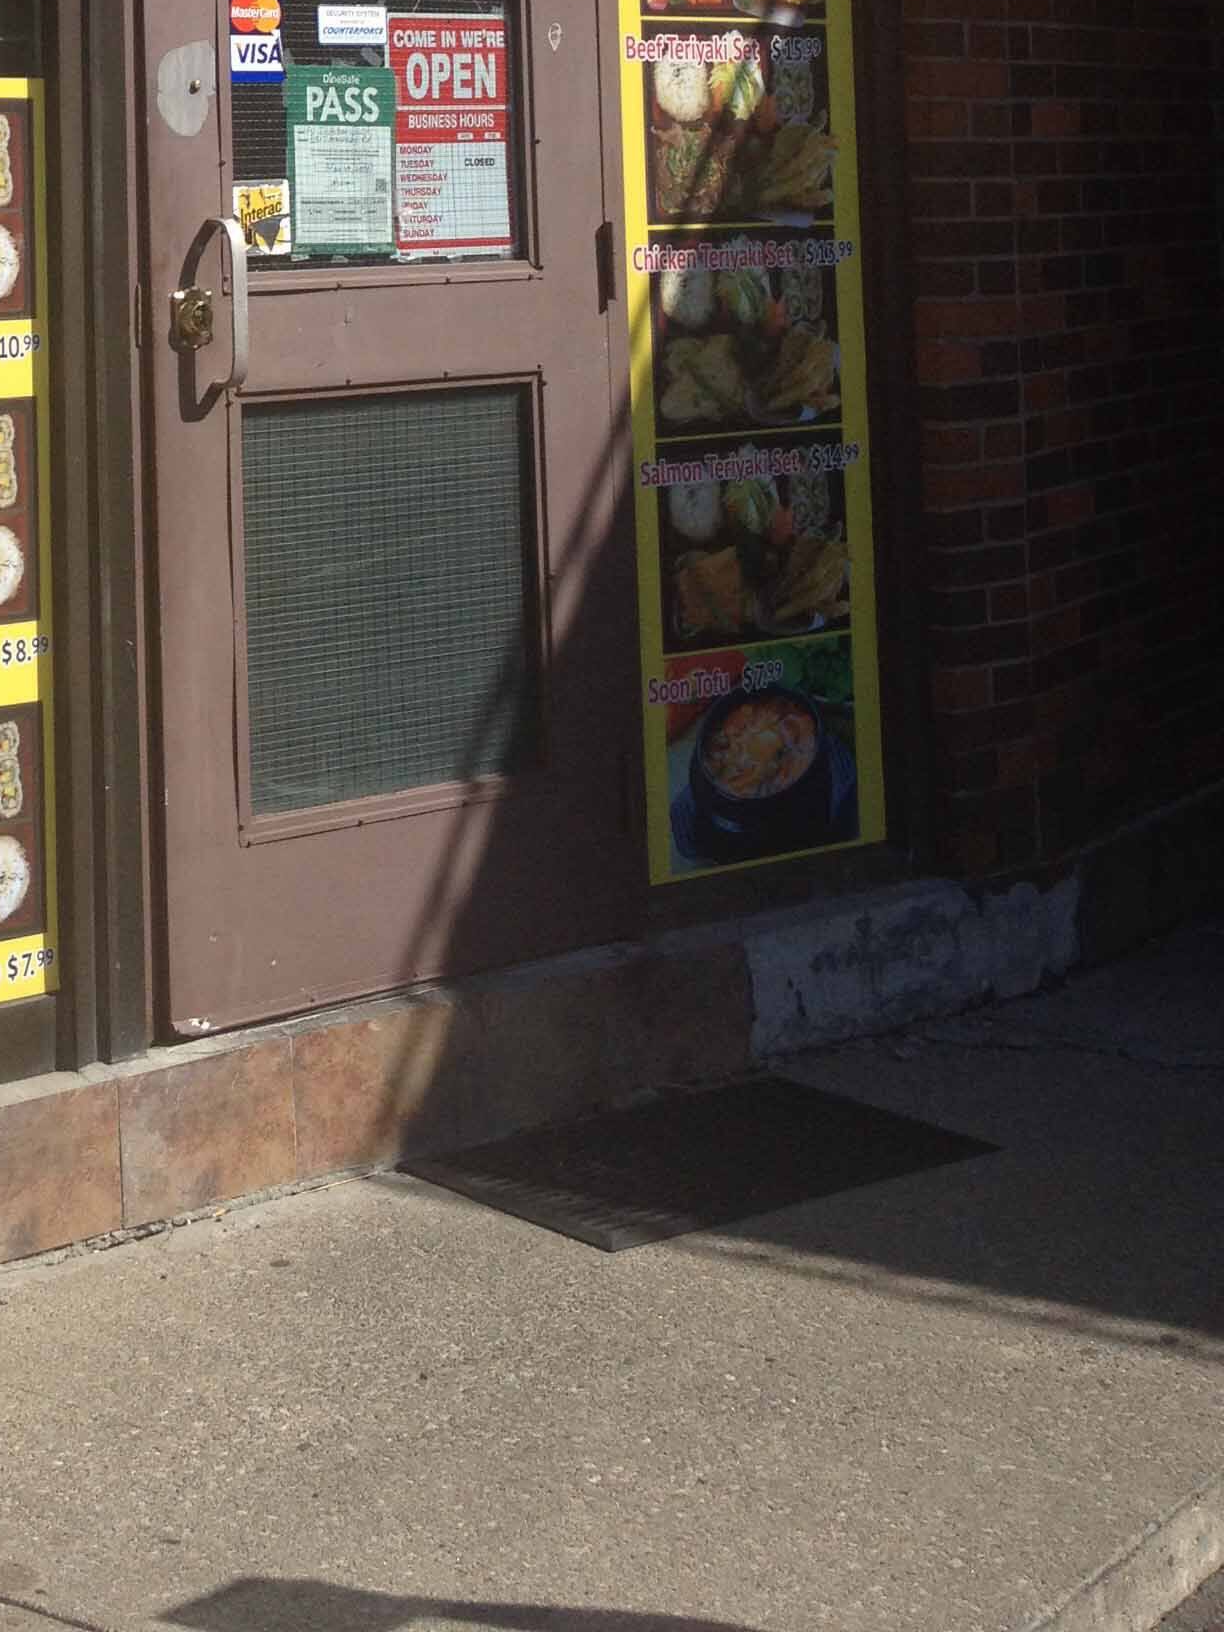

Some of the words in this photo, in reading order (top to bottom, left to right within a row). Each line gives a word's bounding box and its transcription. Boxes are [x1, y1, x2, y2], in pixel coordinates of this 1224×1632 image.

[231, 6, 281, 19] MasterCard
[236, 38, 281, 65] VISA
[393, 29, 437, 48] COME
[440, 29, 457, 48] IN
[460, 29, 505, 48] WE'RE
[625, 35, 665, 60] Beef
[666, 35, 727, 66] Teriyaki
[733, 37, 759, 61] Set
[406, 52, 497, 99] OPEN
[306, 85, 381, 123] PASS
[407, 114, 458, 129] BUSINESS
[459, 113, 495, 128] HOURS
[399, 146, 433, 155] MONDAY
[400, 159, 434, 168] TUESDAY
[464, 157, 495, 167] CLOSED
[400, 173, 448, 183] WEDNESDAY
[240, 200, 282, 229] Interac
[633, 244, 697, 271] Chicken
[700, 242, 763, 272] Teriyaki
[766, 241, 793, 267] Set
[641, 457, 702, 487] Salmon
[648, 677, 691, 705] Soon
[695, 669, 731, 698] Tofu
